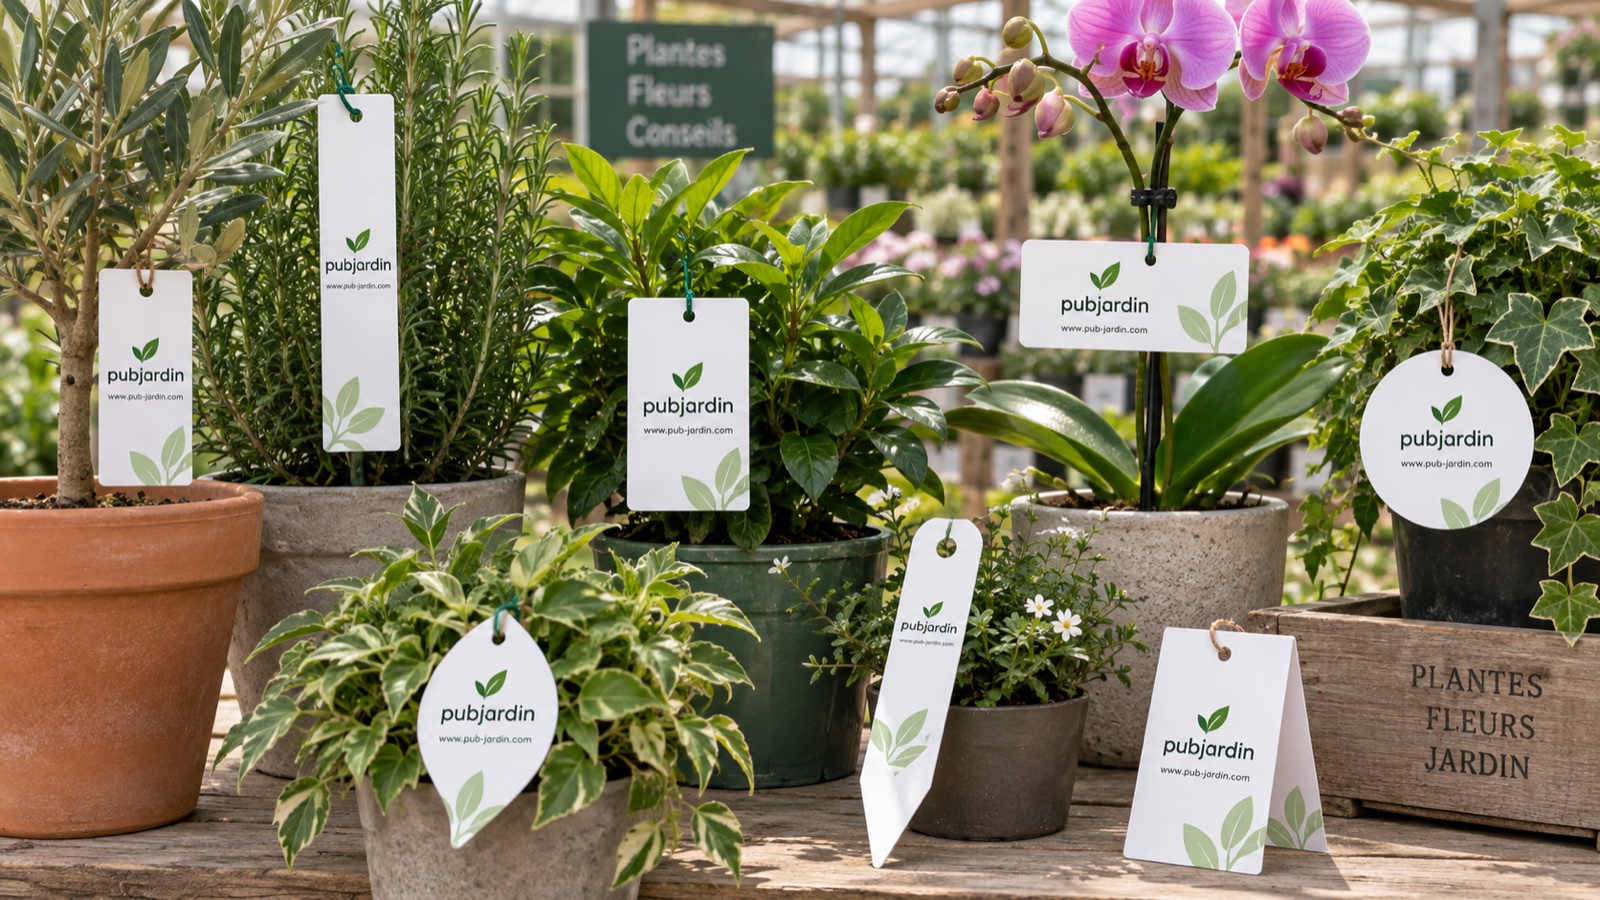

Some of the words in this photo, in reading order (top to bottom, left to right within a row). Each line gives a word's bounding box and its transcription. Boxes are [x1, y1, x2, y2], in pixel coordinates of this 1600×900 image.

[627, 34, 725, 66] Plantes
[627, 74, 712, 107] Fleurs
[626, 115, 737, 147] Conseils
[325, 257, 392, 275] pubjardin
[325, 282, 392, 291] www.pub-jardin.com
[1061, 295, 1149, 317] pubjardin
[1060, 324, 1148, 336] www.pub-jardin.com
[107, 367, 184, 386] pubjardin
[107, 393, 184, 402] www.pub-jardin.com
[643, 396, 734, 418] pubjardin
[643, 425, 734, 437] www.pub-jardin.com
[1400, 429, 1494, 451] pubjardin
[1400, 459, 1493, 471] www.pub-jardin.com
[900, 621, 958, 635] pubjardin
[1411, 663, 1544, 699] PLANTES
[440, 704, 535, 726] pubjardin
[1425, 705, 1535, 740] FLEURS
[438, 734, 532, 745] www.pub-jardin.com
[1162, 736, 1255, 762] pubjardin
[1424, 746, 1531, 780] JARDIN
[1160, 766, 1250, 783] www.pub-jardin.com
